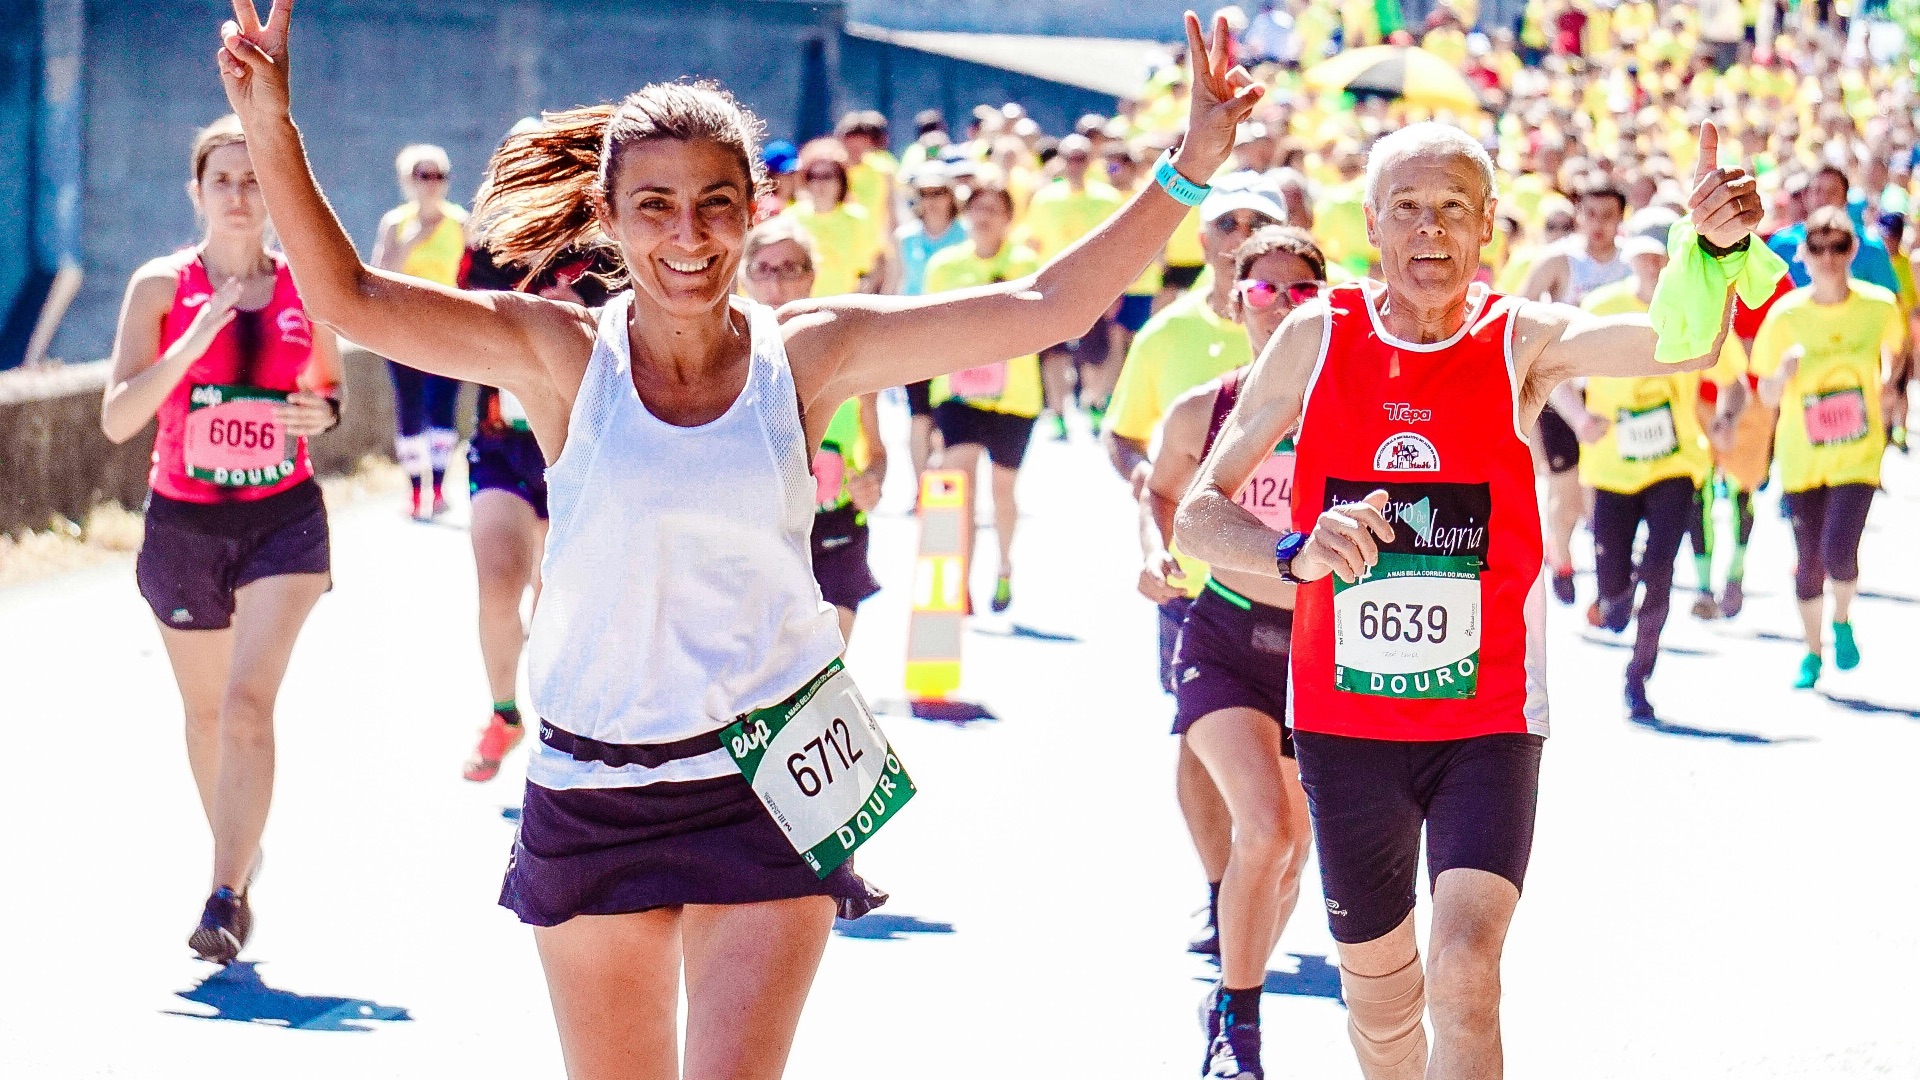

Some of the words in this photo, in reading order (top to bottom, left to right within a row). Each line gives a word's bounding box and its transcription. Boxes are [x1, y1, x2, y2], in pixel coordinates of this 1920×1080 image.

[210, 418, 274, 449] 6056
[214, 459, 295, 485] DOURO
[1239, 477, 1291, 507] 124
[1414, 508, 1483, 555] alegria
[1360, 601, 1448, 644] 6639
[1370, 658, 1475, 694] DOURO
[787, 718, 863, 797] 6712
[836, 753, 900, 849] DOURO
